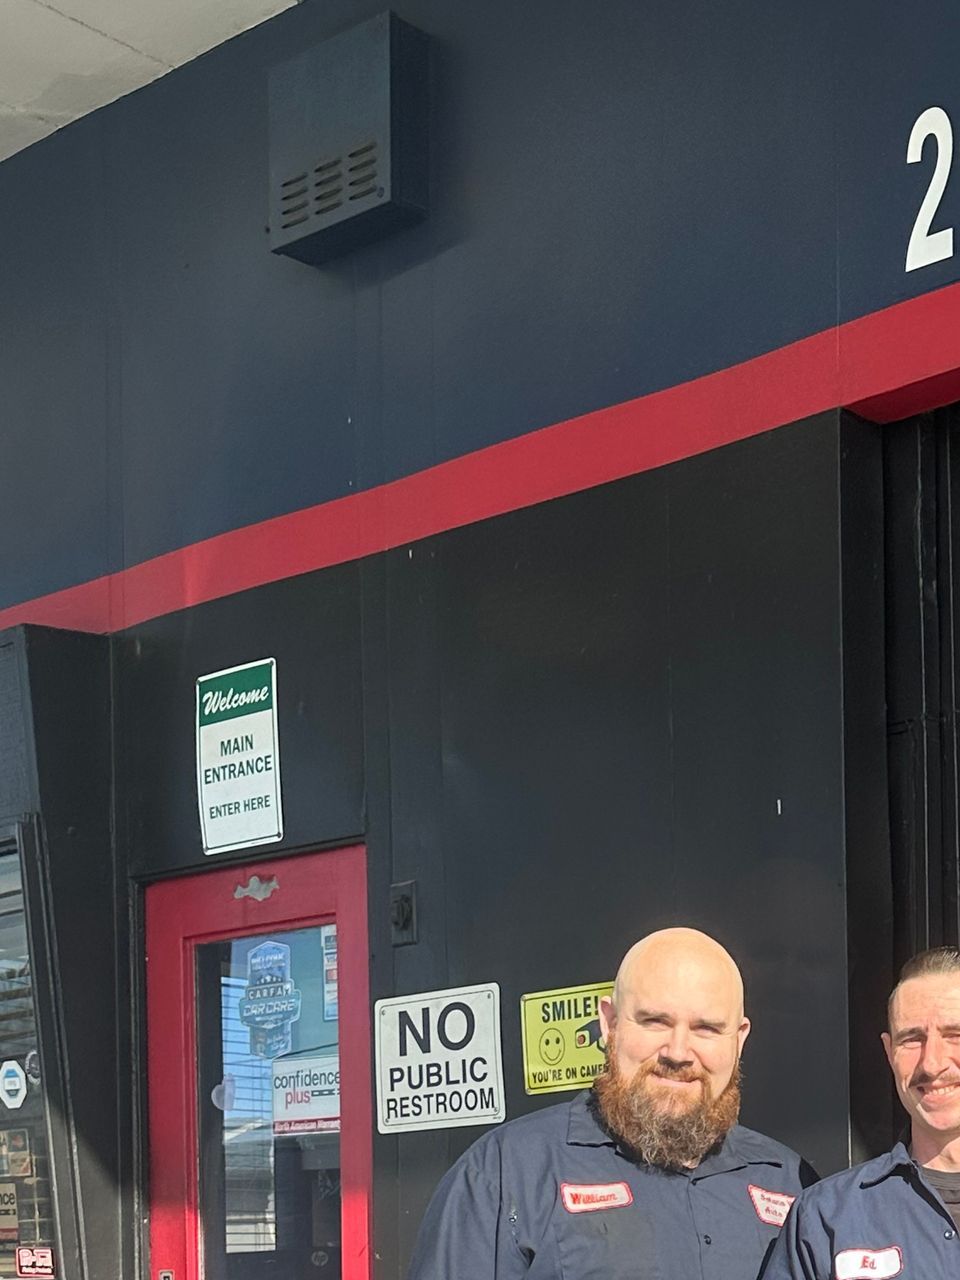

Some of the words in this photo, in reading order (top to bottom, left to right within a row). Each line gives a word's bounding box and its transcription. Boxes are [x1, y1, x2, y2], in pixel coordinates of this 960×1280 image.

[202, 685, 269, 716] Welcome
[220, 734, 254, 757] MAIN
[204, 755, 273, 785] ENTRANCE
[209, 801, 241, 819] ENTER
[243, 795, 271, 815] HERE
[243, 1002, 266, 1017] CAR
[265, 998, 296, 1014] CARE
[541, 996, 599, 1024] SMILE!
[398, 1001, 475, 1057] NO
[273, 1069, 340, 1089] confidence
[389, 1057, 488, 1092] PUBLIC
[532, 1069, 562, 1084] YOU'RE
[565, 1067, 577, 1079] ON
[285, 1088, 311, 1110] plus
[386, 1087, 495, 1119] RESTROOM
[570, 1192, 617, 1205] William
[860, 1255, 877, 1270] Ed
